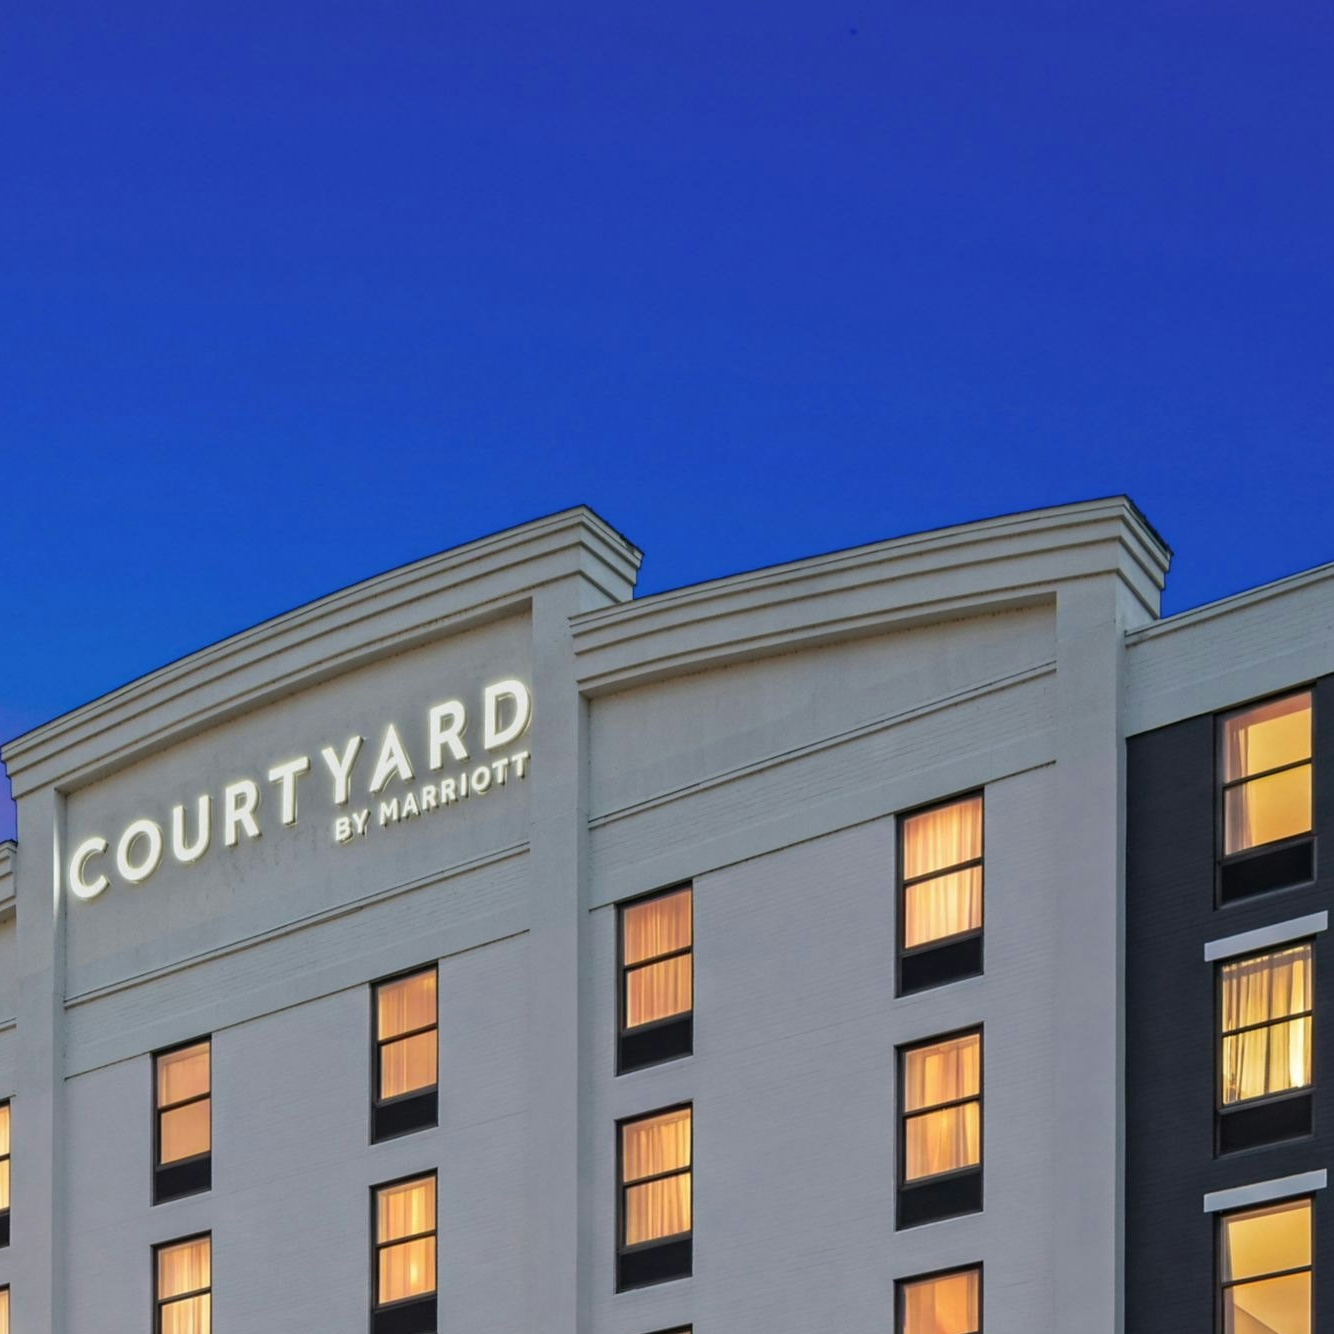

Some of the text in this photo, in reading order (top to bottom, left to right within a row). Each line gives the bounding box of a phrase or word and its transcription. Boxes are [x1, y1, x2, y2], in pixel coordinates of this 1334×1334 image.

[69, 679, 531, 899] COURTYARD
[335, 750, 531, 843] BY MARRIOTT
